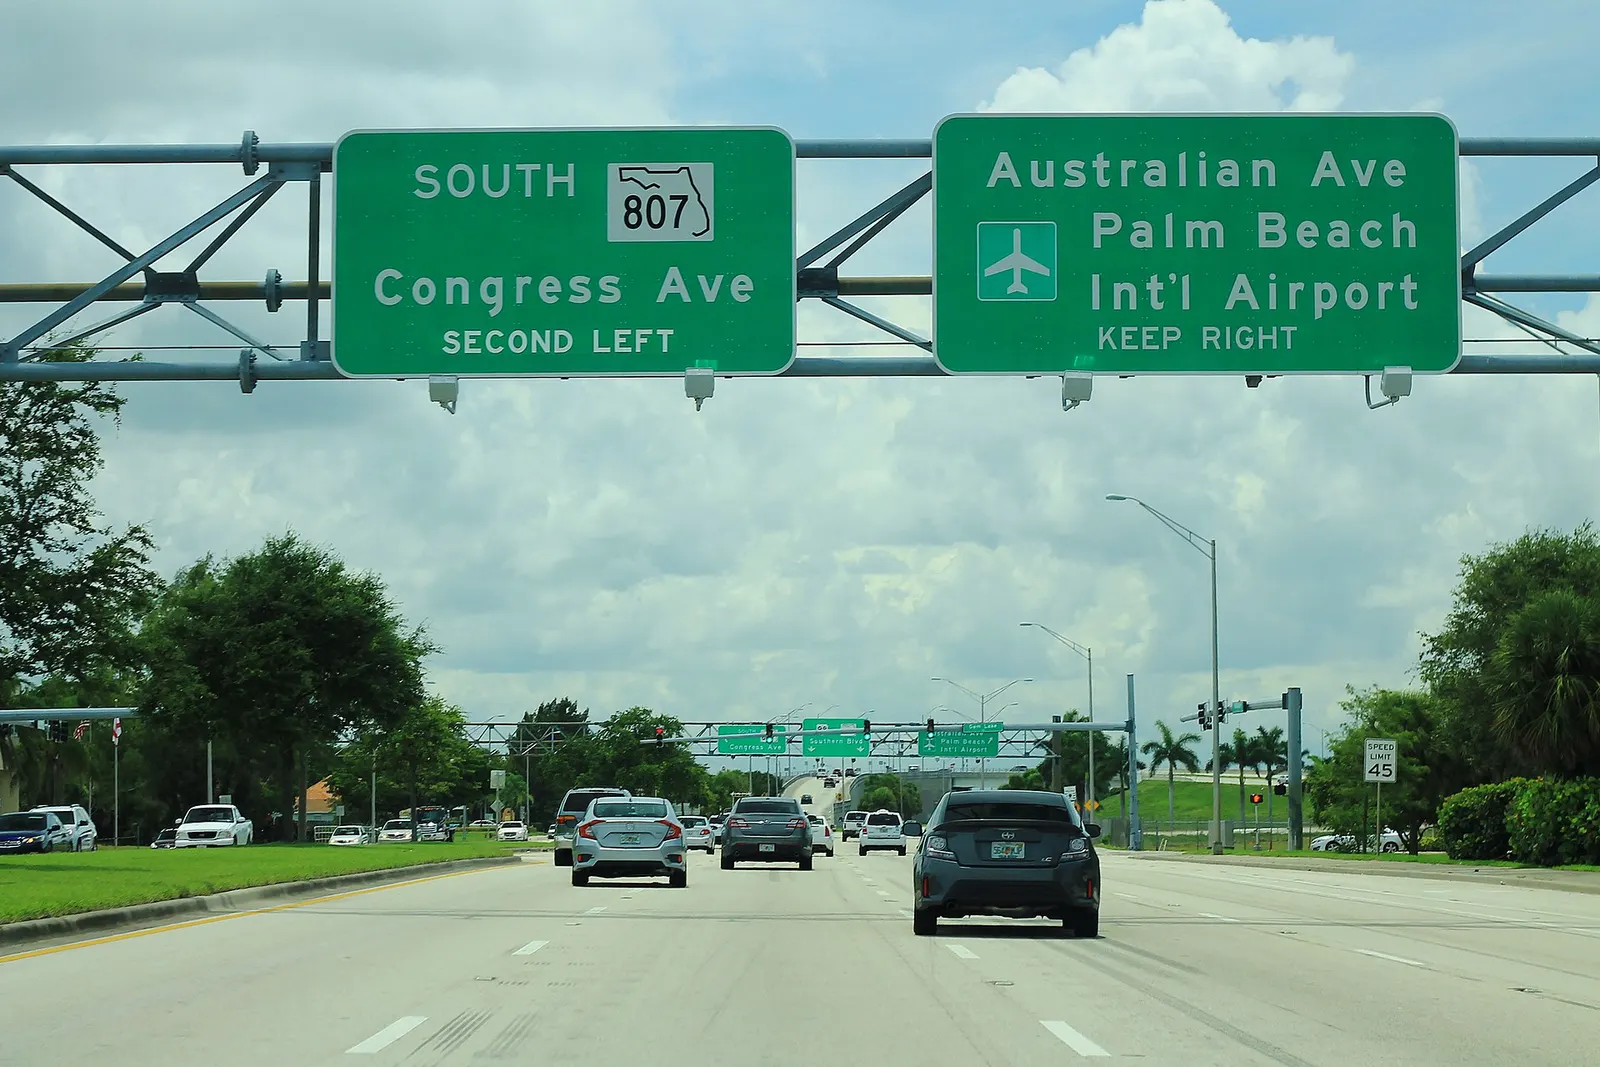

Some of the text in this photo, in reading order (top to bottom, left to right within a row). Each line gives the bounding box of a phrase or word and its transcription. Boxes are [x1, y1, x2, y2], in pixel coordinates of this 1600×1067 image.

[413, 162, 576, 199] SOUTH
[986, 151, 1407, 188] Australian Ave
[623, 194, 689, 229] 807
[1092, 212, 1418, 248] Palm Beach
[374, 267, 755, 317] Congress Ave
[1091, 273, 1420, 320] Int'l Airport
[442, 329, 675, 355] SECOND LEFT
[1098, 326, 1297, 350] KEEP RIGHT
[729, 743, 782, 752] Congress Ave
[809, 737, 864, 745] Southern Blvd
[1368, 763, 1393, 777] 45
